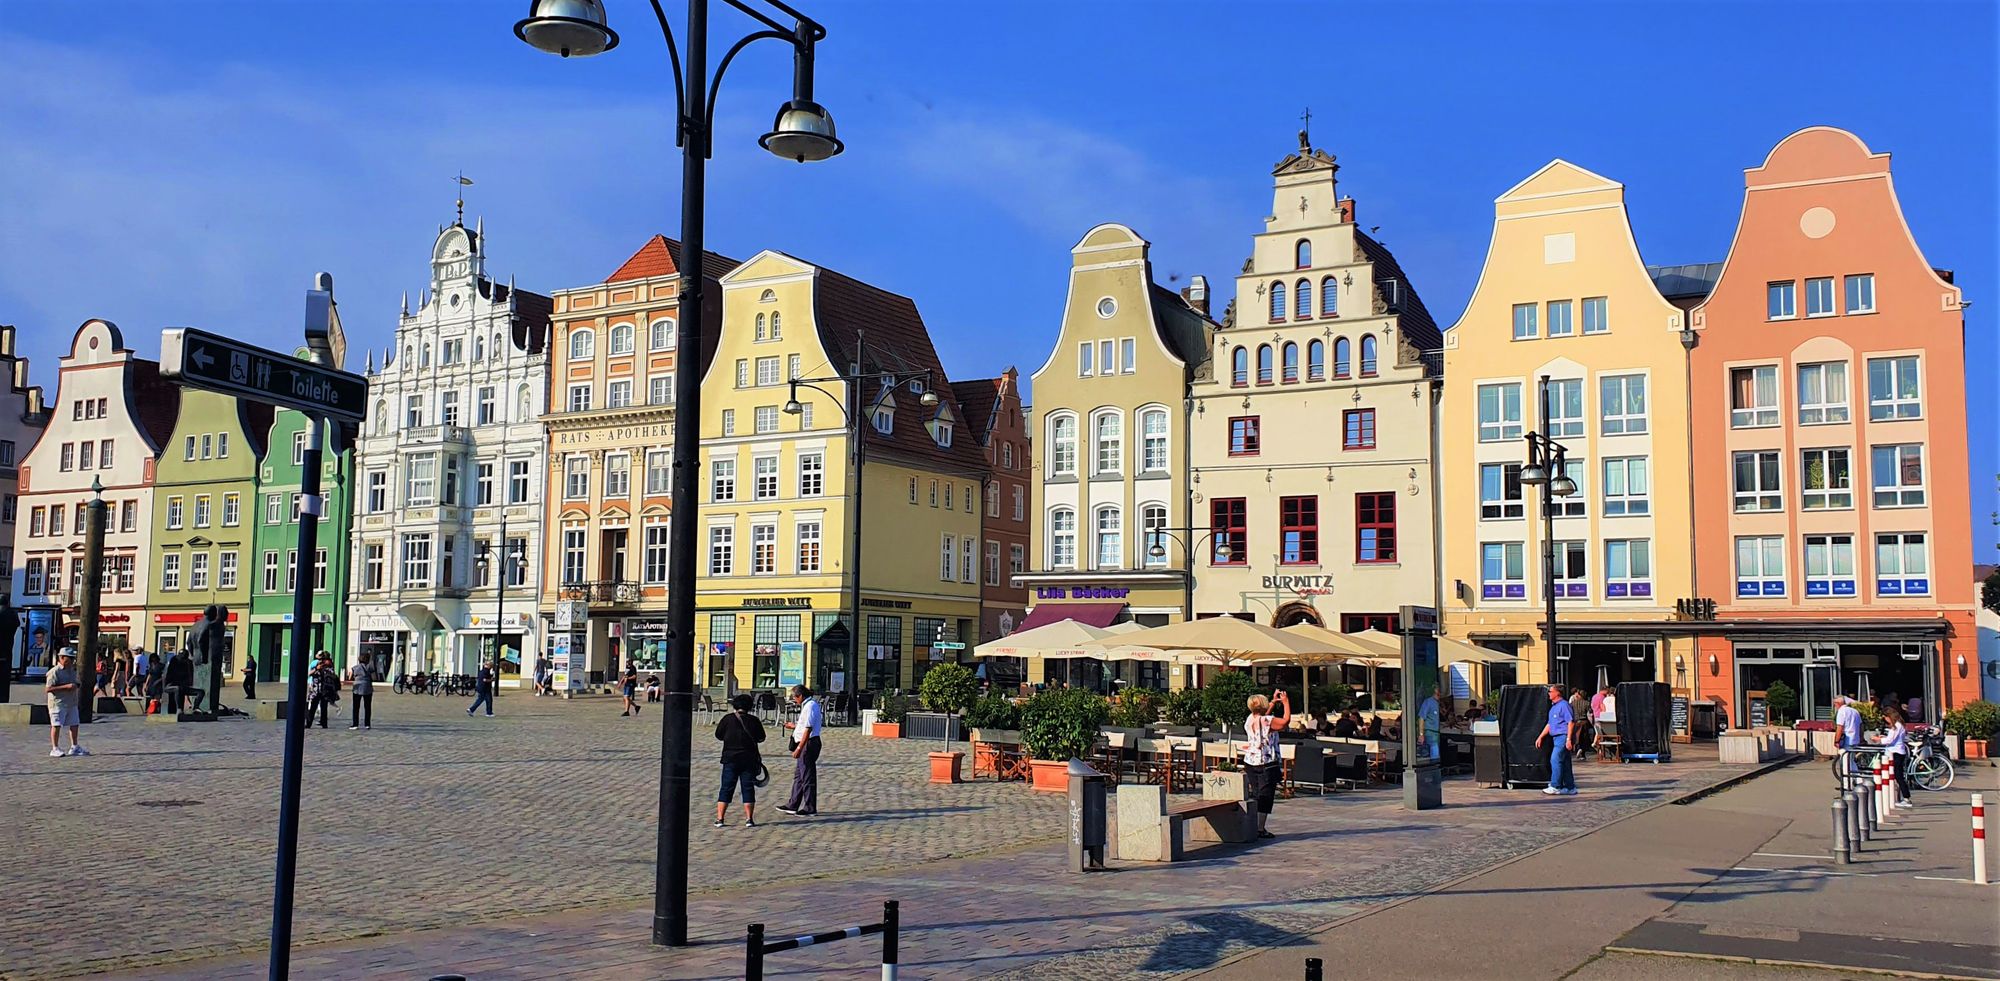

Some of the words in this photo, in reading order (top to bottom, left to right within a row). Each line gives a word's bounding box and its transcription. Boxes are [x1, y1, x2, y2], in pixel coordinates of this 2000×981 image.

[289, 369, 339, 404] Toilette
[560, 431, 590, 444] RATS
[1262, 575, 1335, 589] BURWITZ
[1037, 586, 1066, 599] Lila
[1071, 585, 1130, 599] Bäcker
